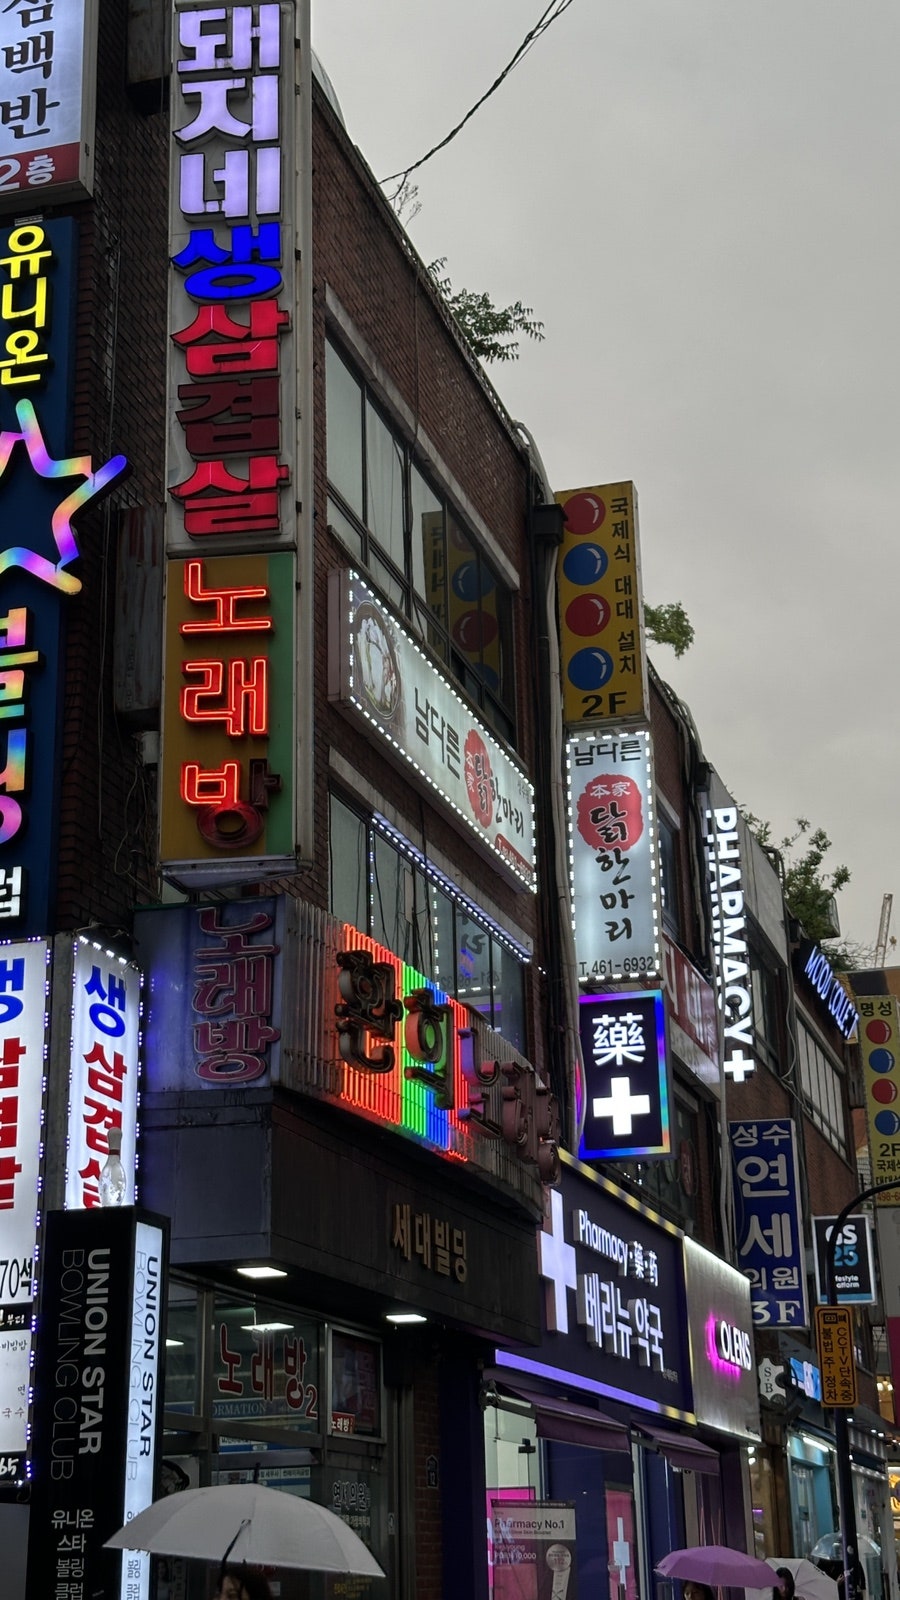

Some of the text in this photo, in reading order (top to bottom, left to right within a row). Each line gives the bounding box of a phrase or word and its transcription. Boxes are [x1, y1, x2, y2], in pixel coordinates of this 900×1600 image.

[179, 558, 282, 849] 노래방
[581, 691, 628, 718] 2F
[574, 740, 642, 767] 남다른
[705, 807, 753, 1045] PHARMACY
[192, 906, 281, 1083] 노래방
[860, 1001, 892, 1017] 명성
[592, 1012, 647, 1066] 藥
[731, 1124, 791, 1147] 성수
[393, 1203, 468, 1283] 세대빌딩
[578, 1209, 628, 1277] Pharmacy
[50, 1248, 85, 1481] BOWLING CLUB
[78, 1248, 111, 1456] UNION STAR
[139, 1255, 159, 1458] UNION STAR
[720, 1320, 751, 1371] OLENS
[51, 1508, 95, 1529] 유니온
[56, 1533, 87, 1553] 스타
[56, 1557, 85, 1578] 볼링
